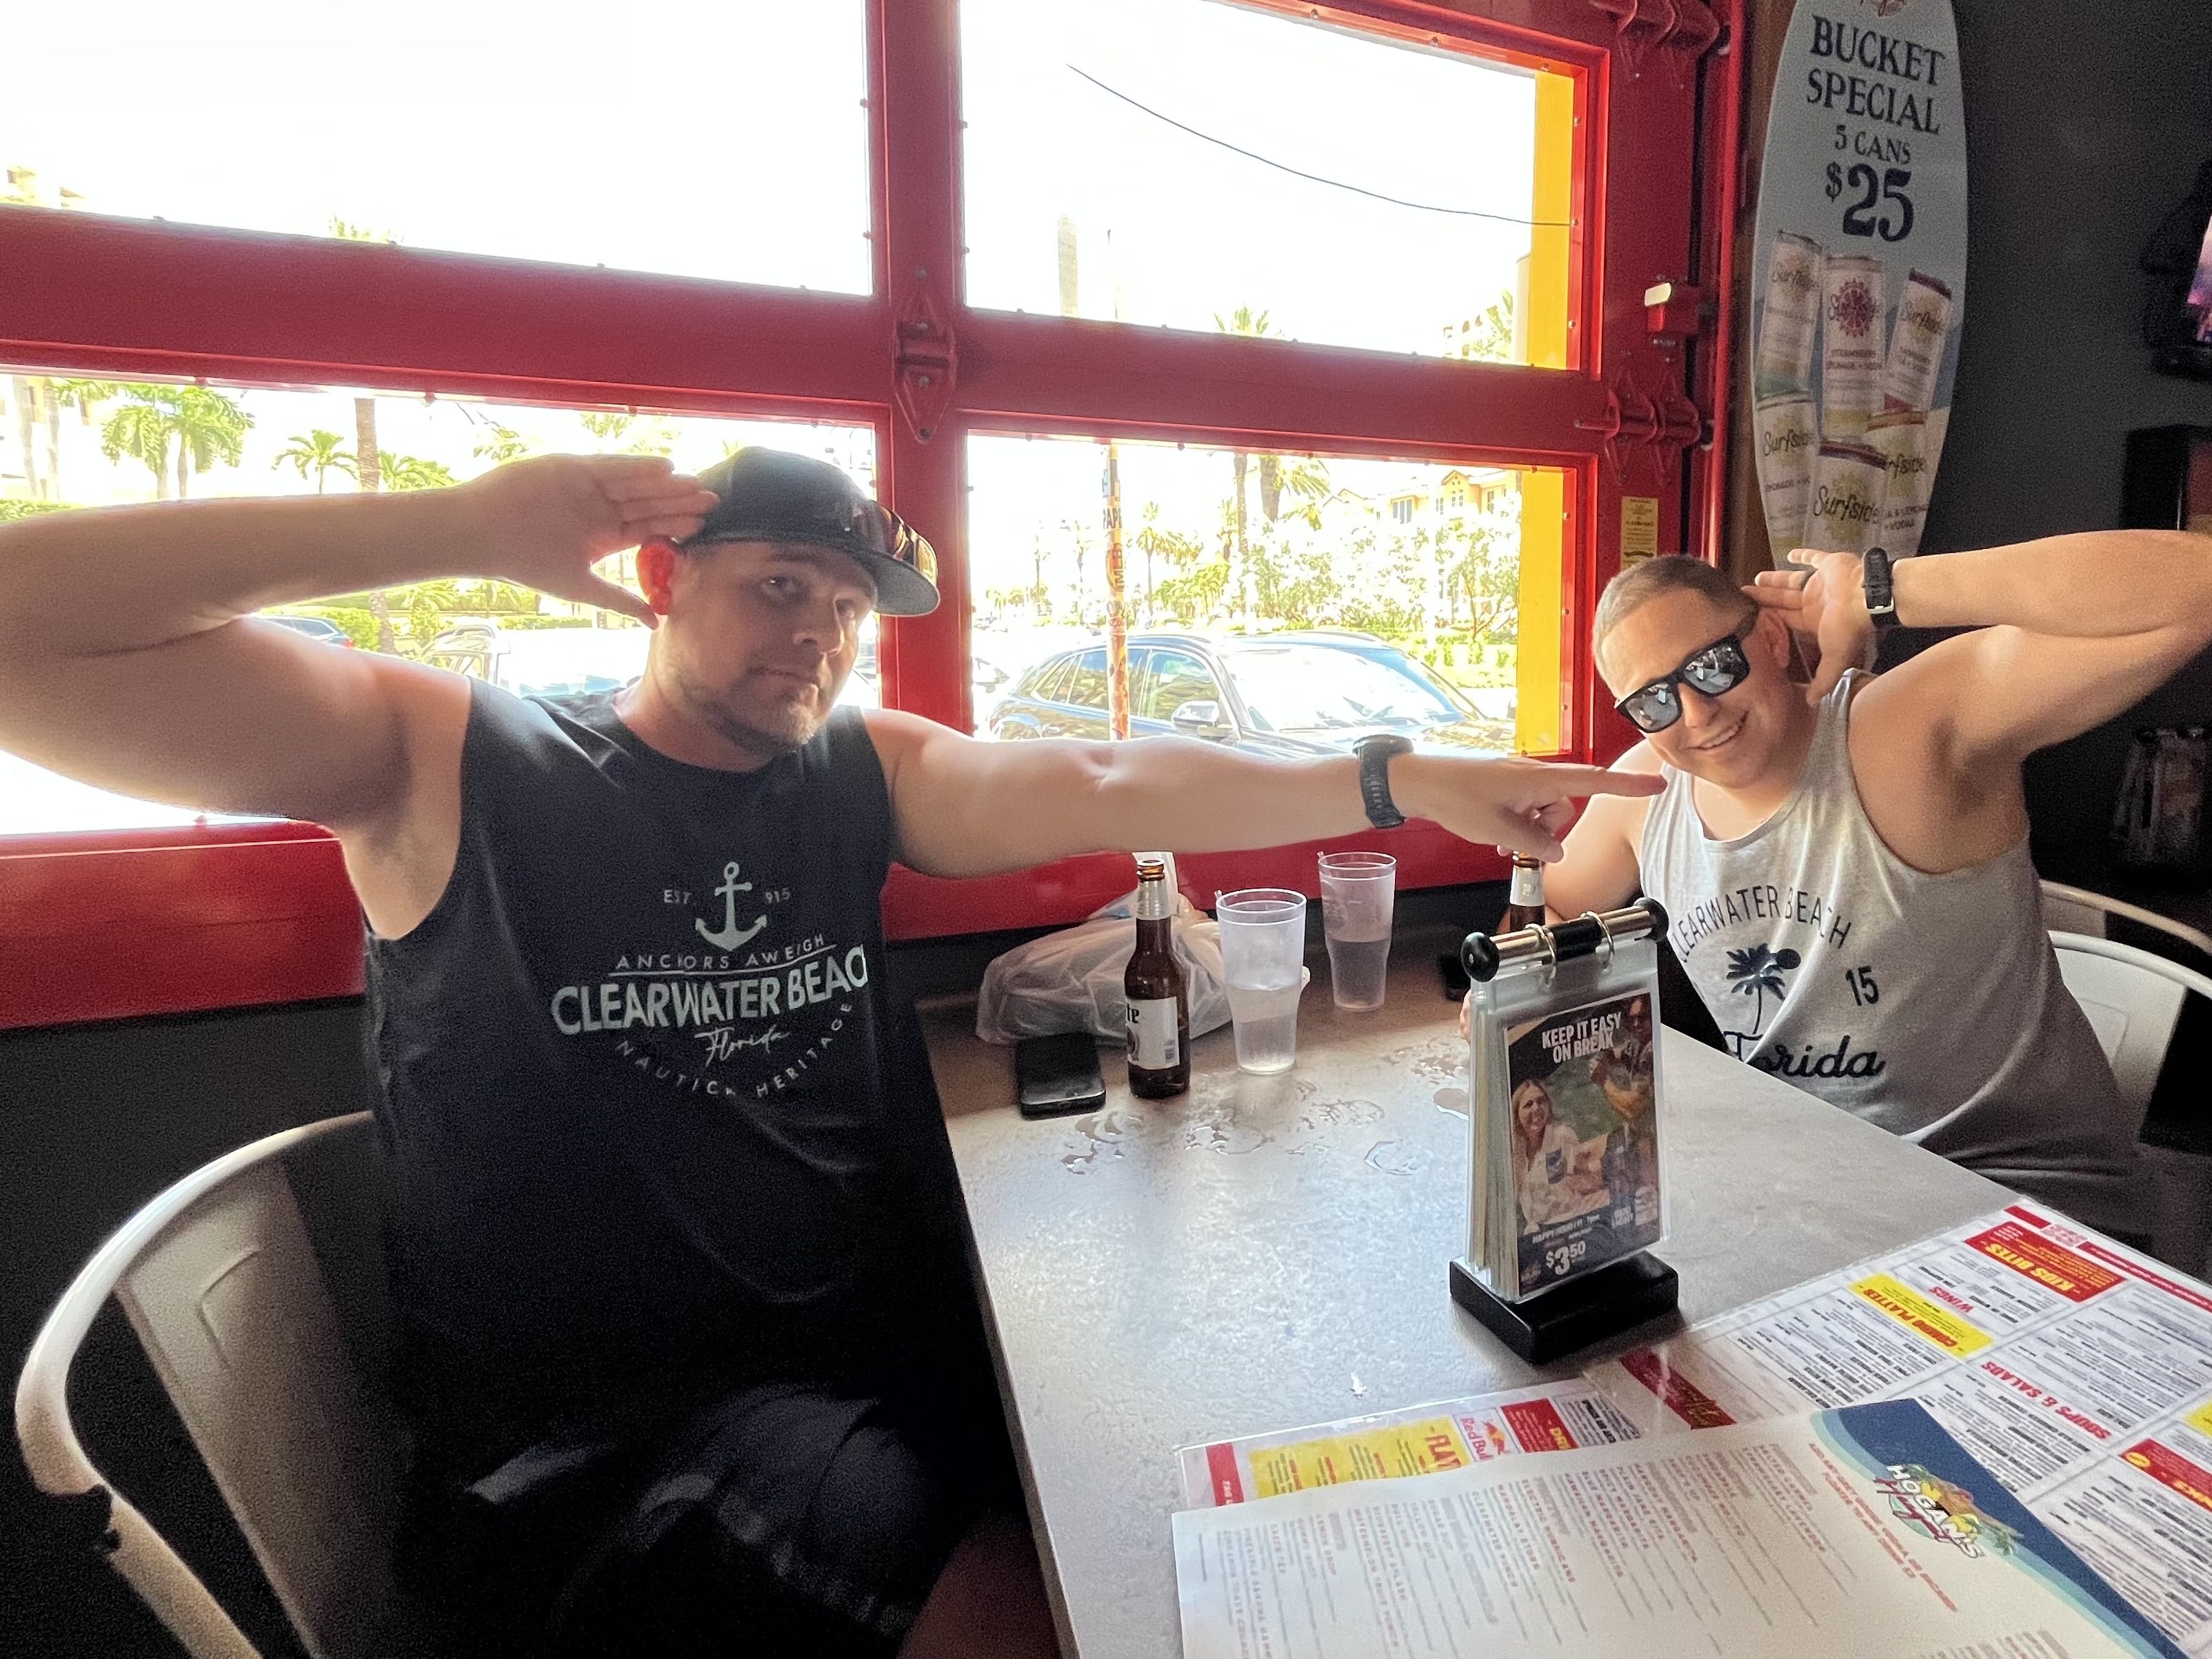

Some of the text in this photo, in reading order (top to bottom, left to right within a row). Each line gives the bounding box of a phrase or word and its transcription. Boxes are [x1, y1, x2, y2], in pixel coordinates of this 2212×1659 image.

[1809, 14, 1947, 86] BUCKET
[1807, 68, 1940, 134] SPECIAL
[1834, 123, 1911, 165] 5 CANS
[1825, 161, 1914, 242] $25
[1672, 885, 1780, 963] LEARWATER
[745, 934, 825, 967] AWEIGH
[552, 943, 869, 1036] CLEARWATER BEAC
[1845, 965, 1880, 1007] 15
[694, 1024, 792, 1068] Florida
[755, 1003, 853, 1098] HERITAGE
[1542, 1011, 1623, 1049] KEEP IT EASY
[1553, 1032, 1614, 1064] ON BREAK
[1982, 1242, 2077, 1292] KIDS BITES
[1861, 1288, 1916, 1321] PLATTER
[1927, 1285, 1975, 1313] WINGS
[1979, 1360, 2043, 1399] SALADS
[2038, 1396, 2059, 1407] &
[2053, 1404, 2113, 1441] SOUPS
[1459, 1416, 1482, 1440] Red
[1423, 1434, 1461, 1471] FLAT
[1887, 1464, 1986, 1559] HOGAN'S
